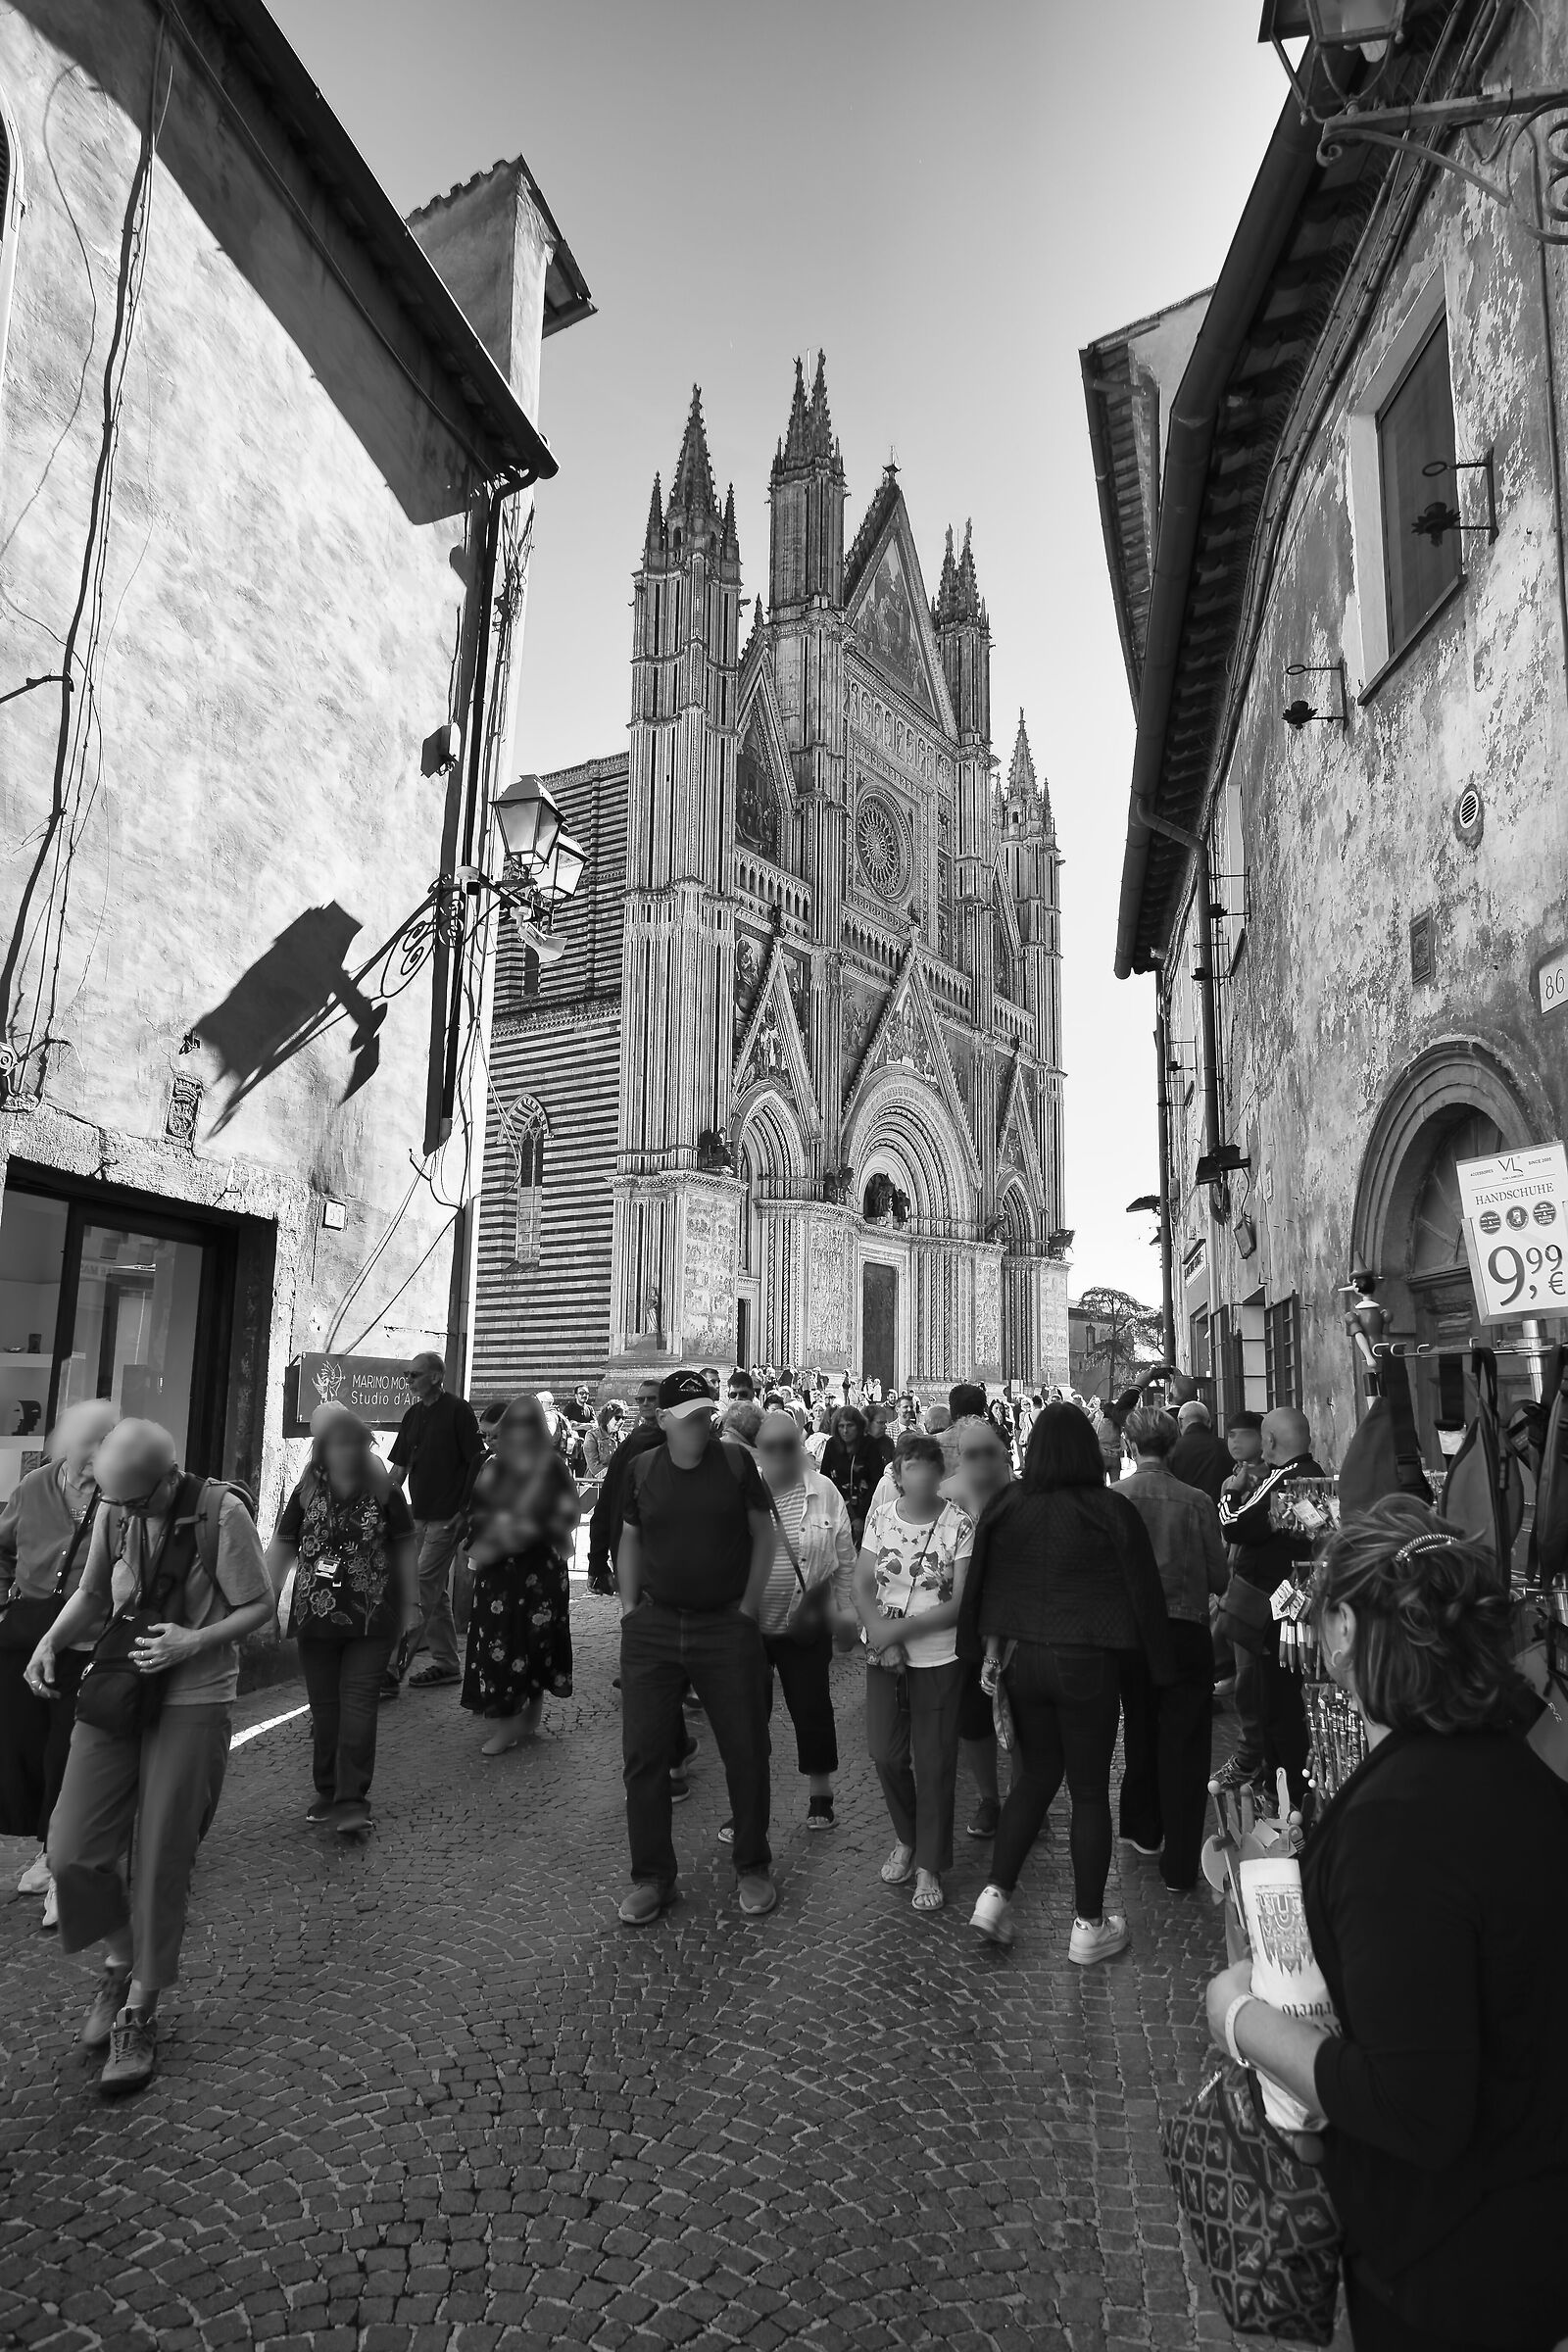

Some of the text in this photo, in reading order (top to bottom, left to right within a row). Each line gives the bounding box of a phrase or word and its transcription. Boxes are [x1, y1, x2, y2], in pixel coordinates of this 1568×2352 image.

[1545, 968, 1565, 1000] 86
[1475, 1182, 1555, 1205] HANDSCHUHE
[352, 1374, 390, 1390] MARINO
[351, 1390, 389, 1405] Studio
